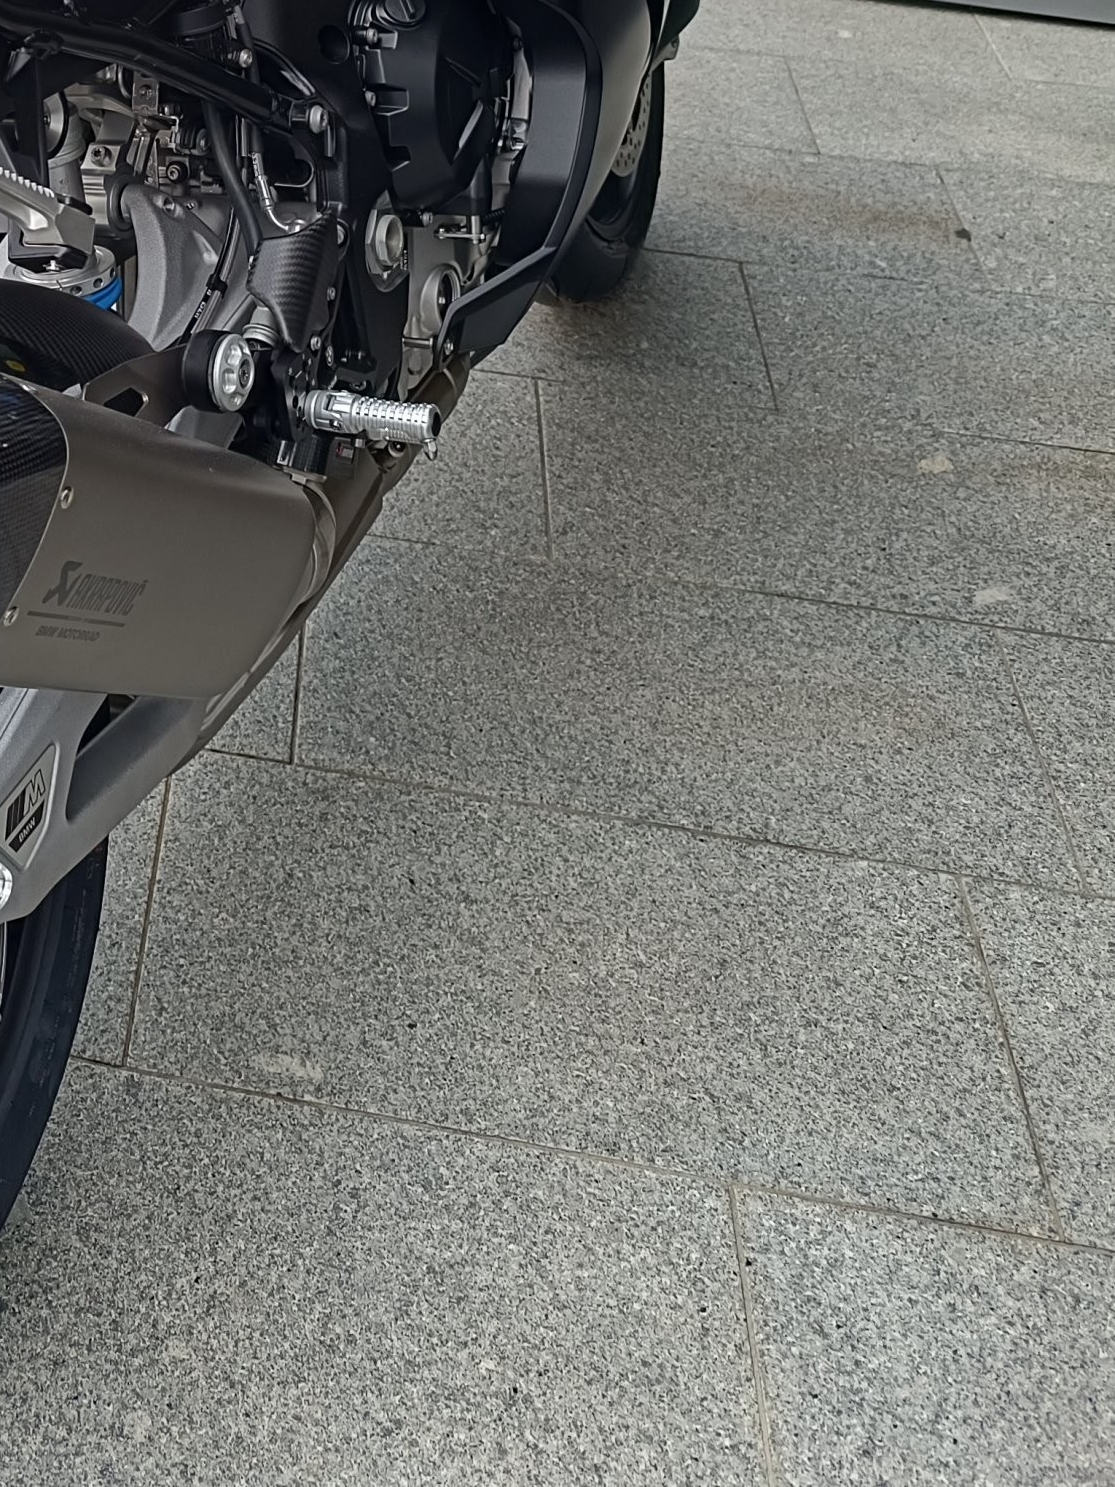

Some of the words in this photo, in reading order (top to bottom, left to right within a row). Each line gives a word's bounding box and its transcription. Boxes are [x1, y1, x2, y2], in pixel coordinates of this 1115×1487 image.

[35, 624, 59, 638] BMW
[57, 626, 101, 642] MOTORRAD
[18, 816, 37, 843] BMW
